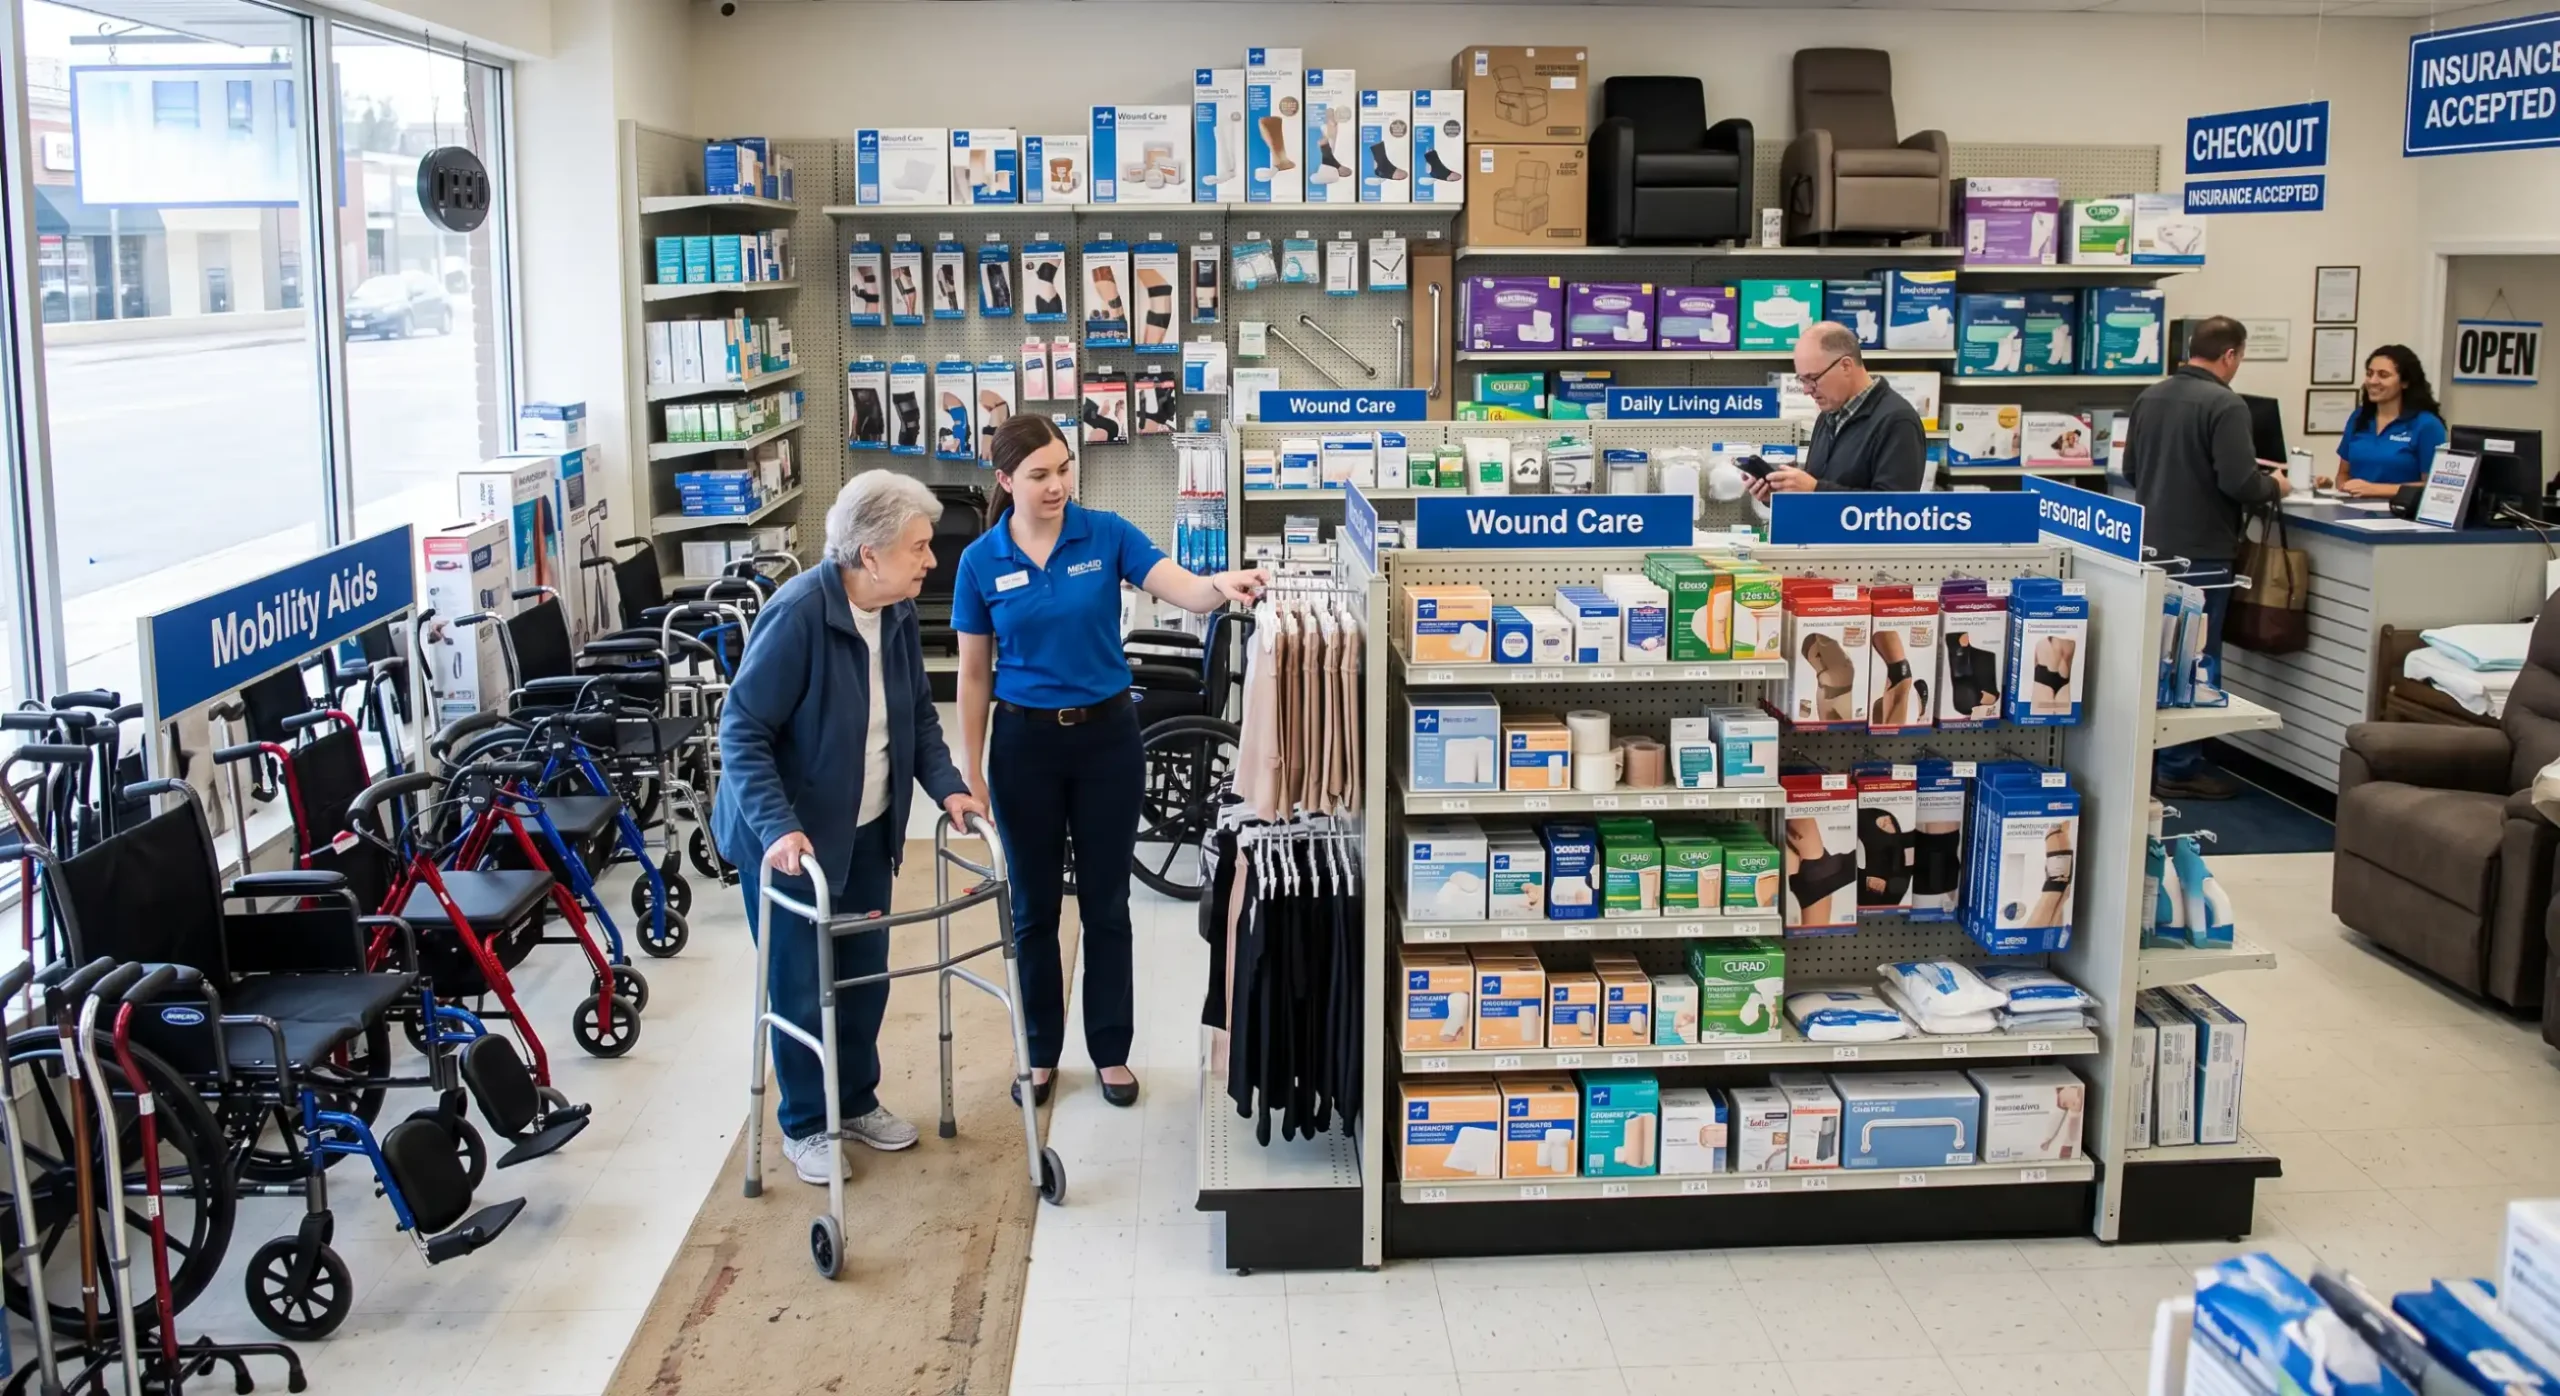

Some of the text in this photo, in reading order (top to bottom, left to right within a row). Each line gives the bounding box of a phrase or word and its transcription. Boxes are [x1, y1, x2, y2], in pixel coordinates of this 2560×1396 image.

[1117, 112, 1168, 121] Wound Care
[2425, 86, 2556, 129] ACCEPTED
[2193, 117, 2319, 161] CHECKOUT
[2188, 183, 2319, 207] INSURANCE ACCEPTED
[2458, 328, 2539, 377] OPEN
[1289, 396, 1397, 414] Wound Care
[1621, 395, 1763, 415] Daily Living Aids
[1466, 508, 1645, 535] Wound Care
[1839, 505, 1972, 532] Orthotics
[2033, 490, 2132, 544] ersonal Care
[211, 562, 378, 669] Mobility Aids
[1723, 961, 1766, 973] CURAD
